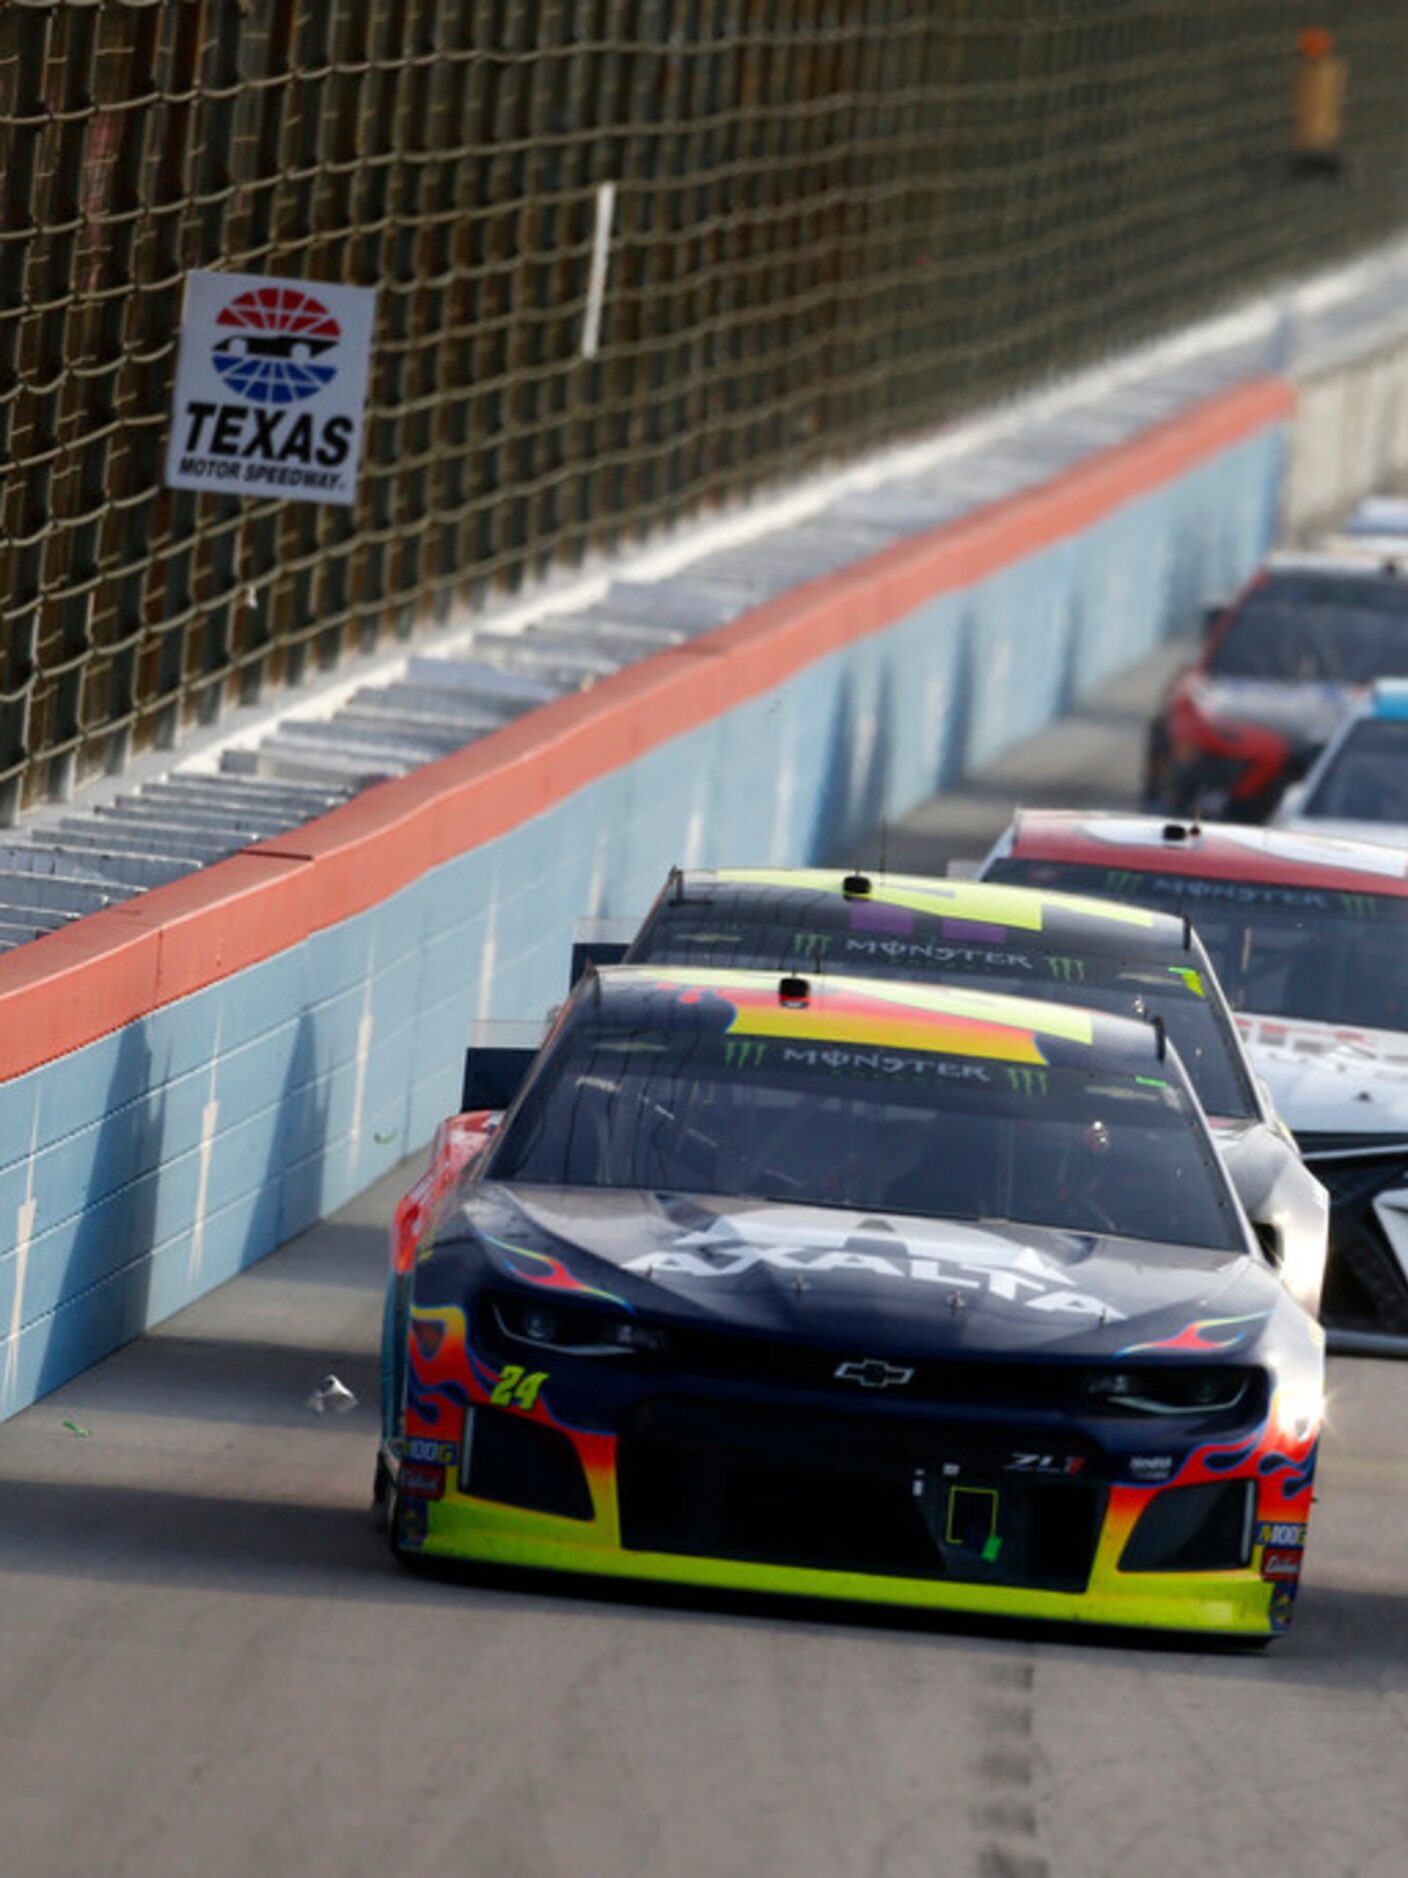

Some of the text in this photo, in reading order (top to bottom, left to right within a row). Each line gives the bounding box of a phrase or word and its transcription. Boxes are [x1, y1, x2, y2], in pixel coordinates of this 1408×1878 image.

[185, 401, 354, 467] TEXAS
[178, 457, 342, 490] MOTOR SPEEDWAY
[1152, 878, 1328, 909] MONSTER
[845, 938, 1033, 969] MONSTER
[782, 1047, 991, 1082] MONSTER
[622, 1246, 1129, 1320] AXALTA
[490, 1364, 549, 1410] 24
